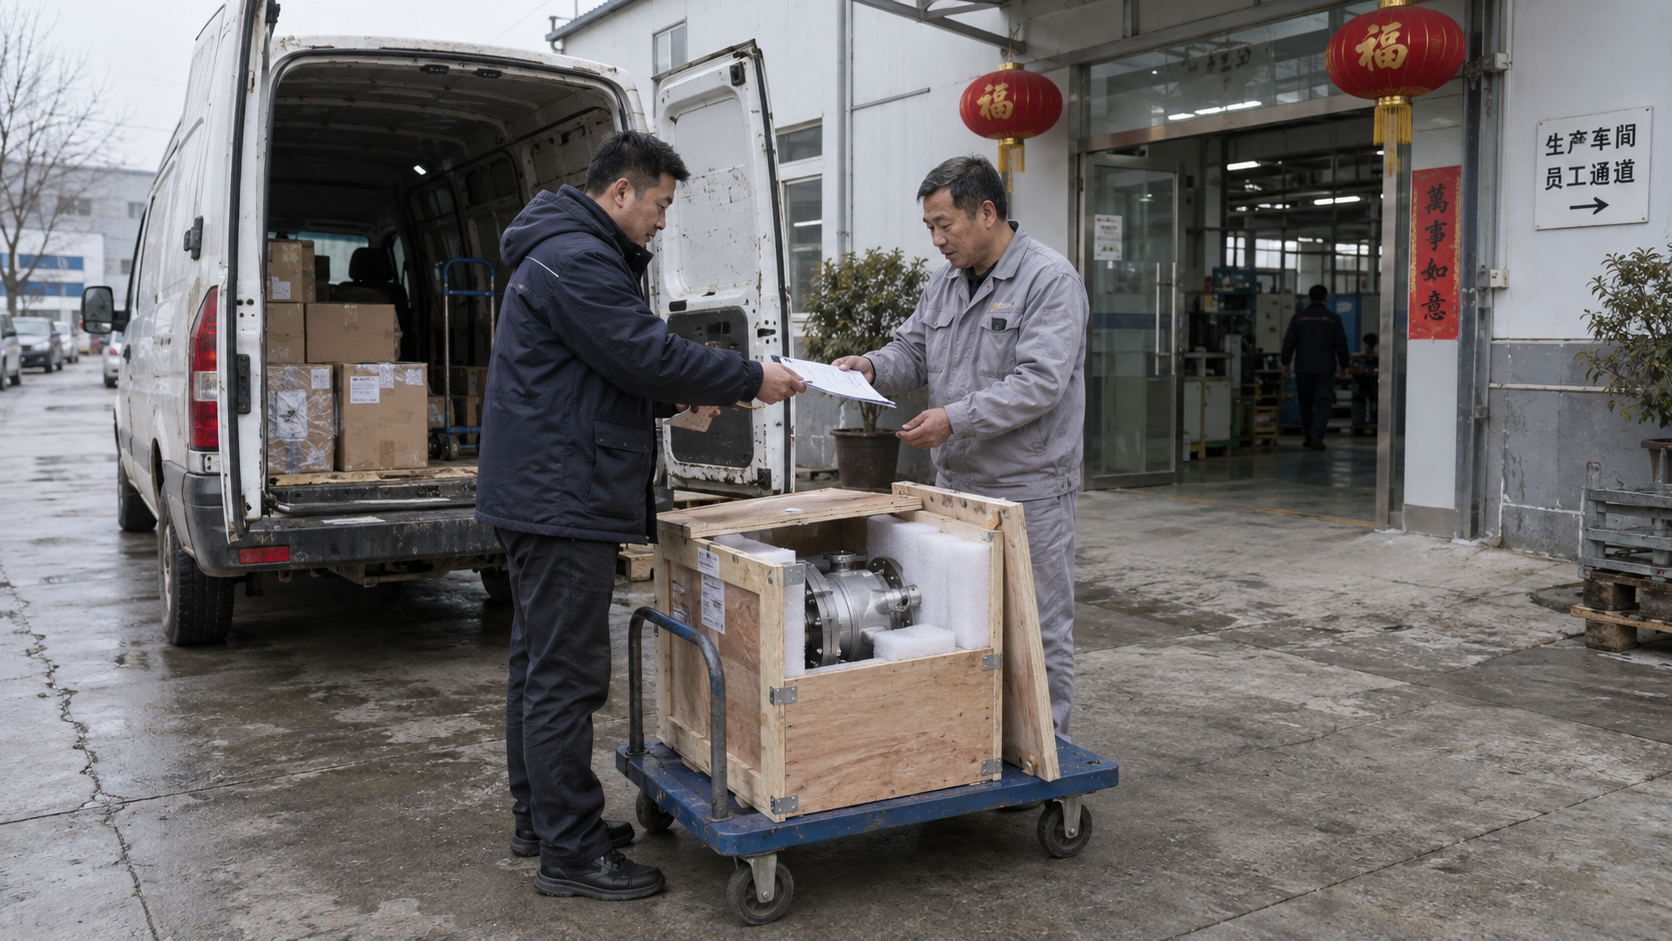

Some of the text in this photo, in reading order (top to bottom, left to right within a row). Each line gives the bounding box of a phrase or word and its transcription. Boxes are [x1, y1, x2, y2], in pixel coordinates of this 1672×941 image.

[1355, 21, 1408, 72] 福
[976, 82, 1014, 121] 福
[1545, 158, 1635, 191] 员工通道
[1420, 182, 1449, 321] 萬事如意
